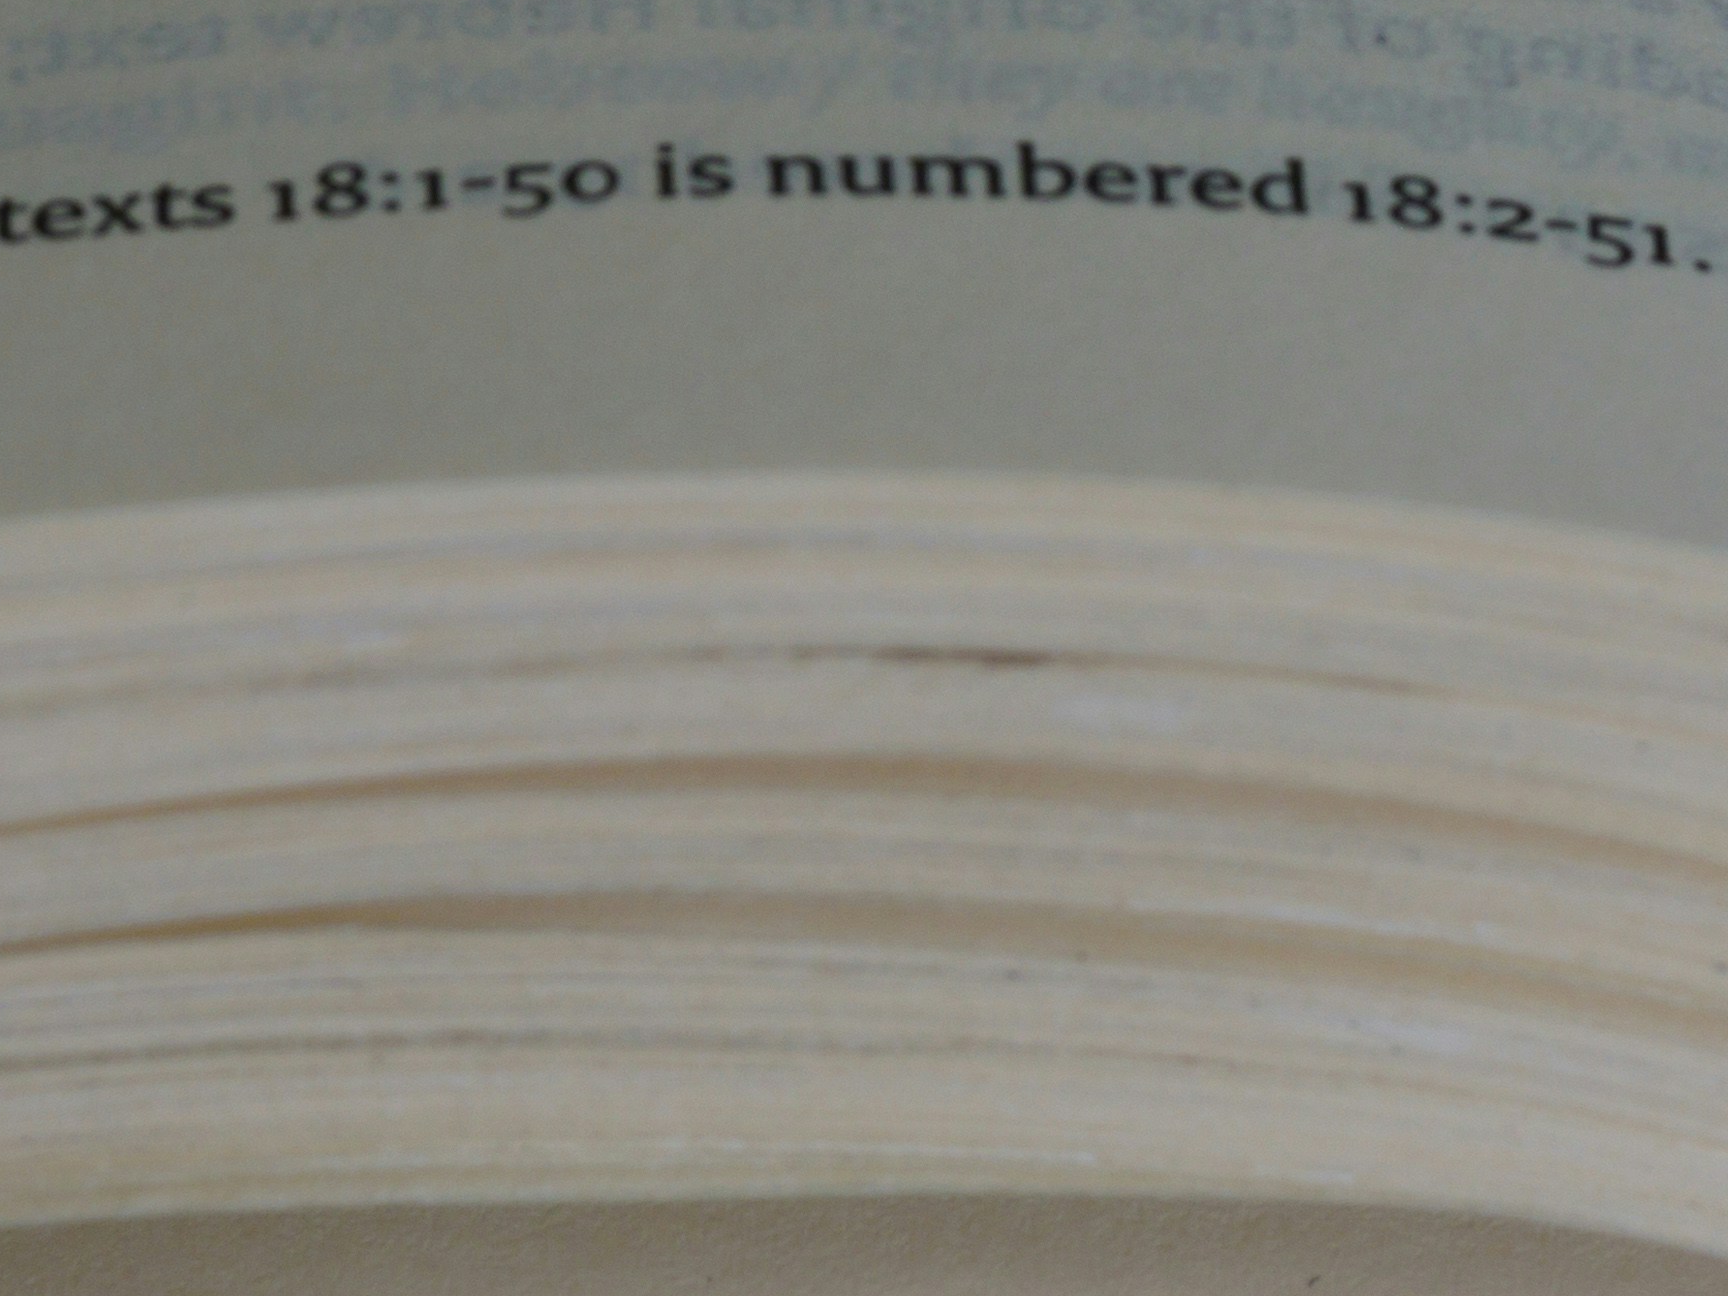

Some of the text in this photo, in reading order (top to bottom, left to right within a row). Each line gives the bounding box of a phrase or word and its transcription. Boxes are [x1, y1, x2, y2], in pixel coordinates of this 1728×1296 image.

[270, 155, 621, 221] 18:1-50
[654, 142, 736, 201] is
[767, 140, 1310, 217] numbered
[1346, 172, 1714, 274] 18:2-51.
